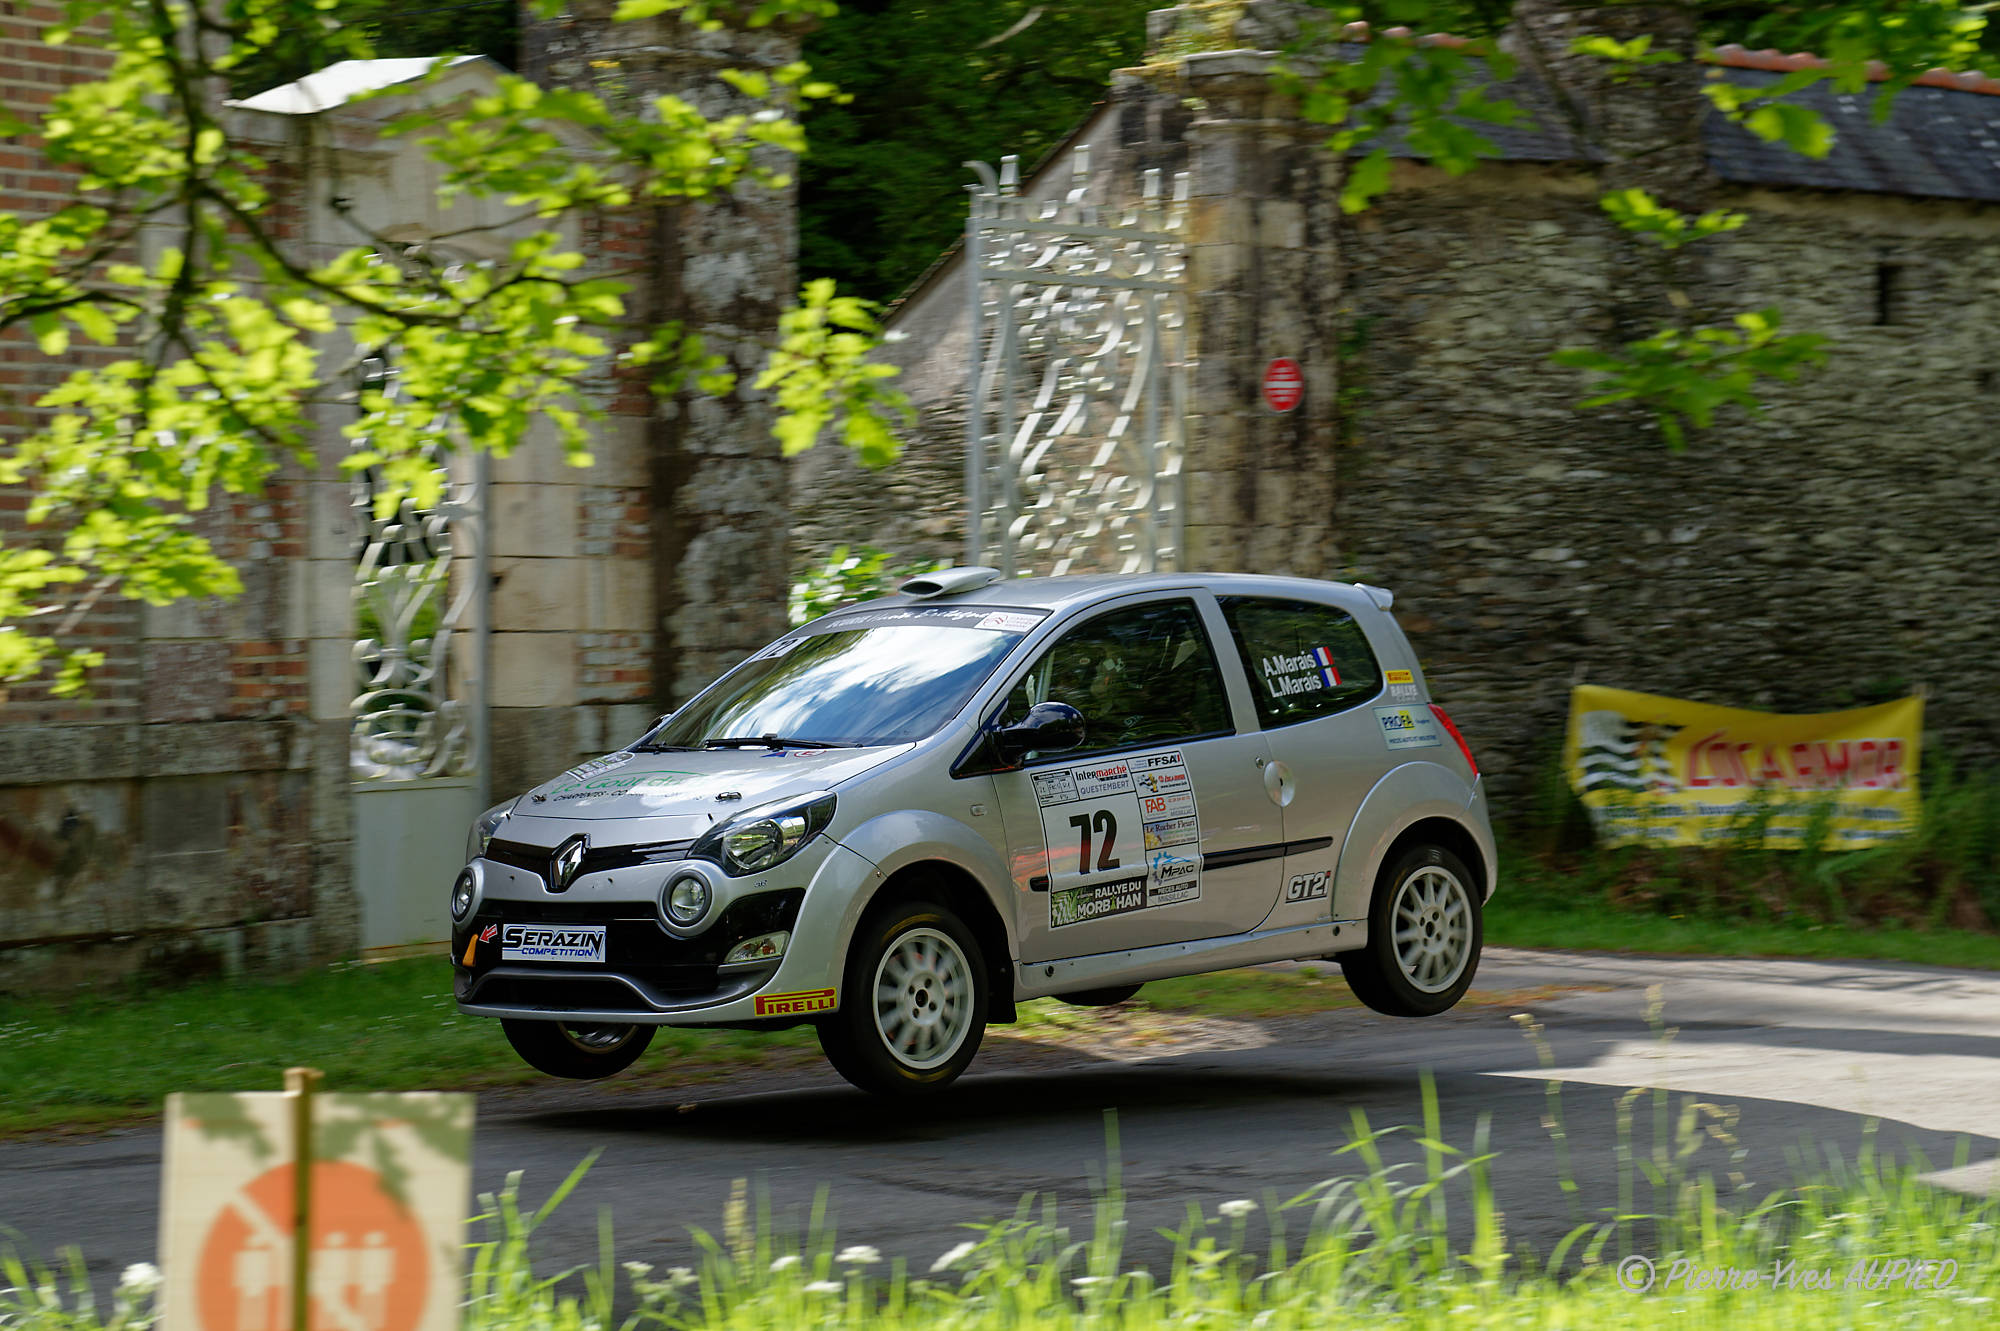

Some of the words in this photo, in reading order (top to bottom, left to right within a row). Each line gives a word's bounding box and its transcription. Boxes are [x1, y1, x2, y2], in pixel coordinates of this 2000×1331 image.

[1263, 650, 1317, 677] A.Marais
[1267, 671, 1322, 698] L.Marais
[1148, 755, 1178, 767] FFSA
[1080, 780, 1130, 795] QUESTEMBERT
[1145, 797, 1167, 814] FAB
[1145, 825, 1154, 833] Le
[1155, 821, 1177, 832] Rucher
[1177, 818, 1195, 829] Fleuri
[1069, 809, 1120, 875] 72
[1160, 864, 1195, 880] MPAC
[1095, 883, 1128, 899] RALLYE
[1128, 880, 1142, 893] DU
[503, 926, 604, 957] SERAZIN
[521, 947, 595, 957] COMPETITION
[755, 988, 835, 1015] PIRELLI
